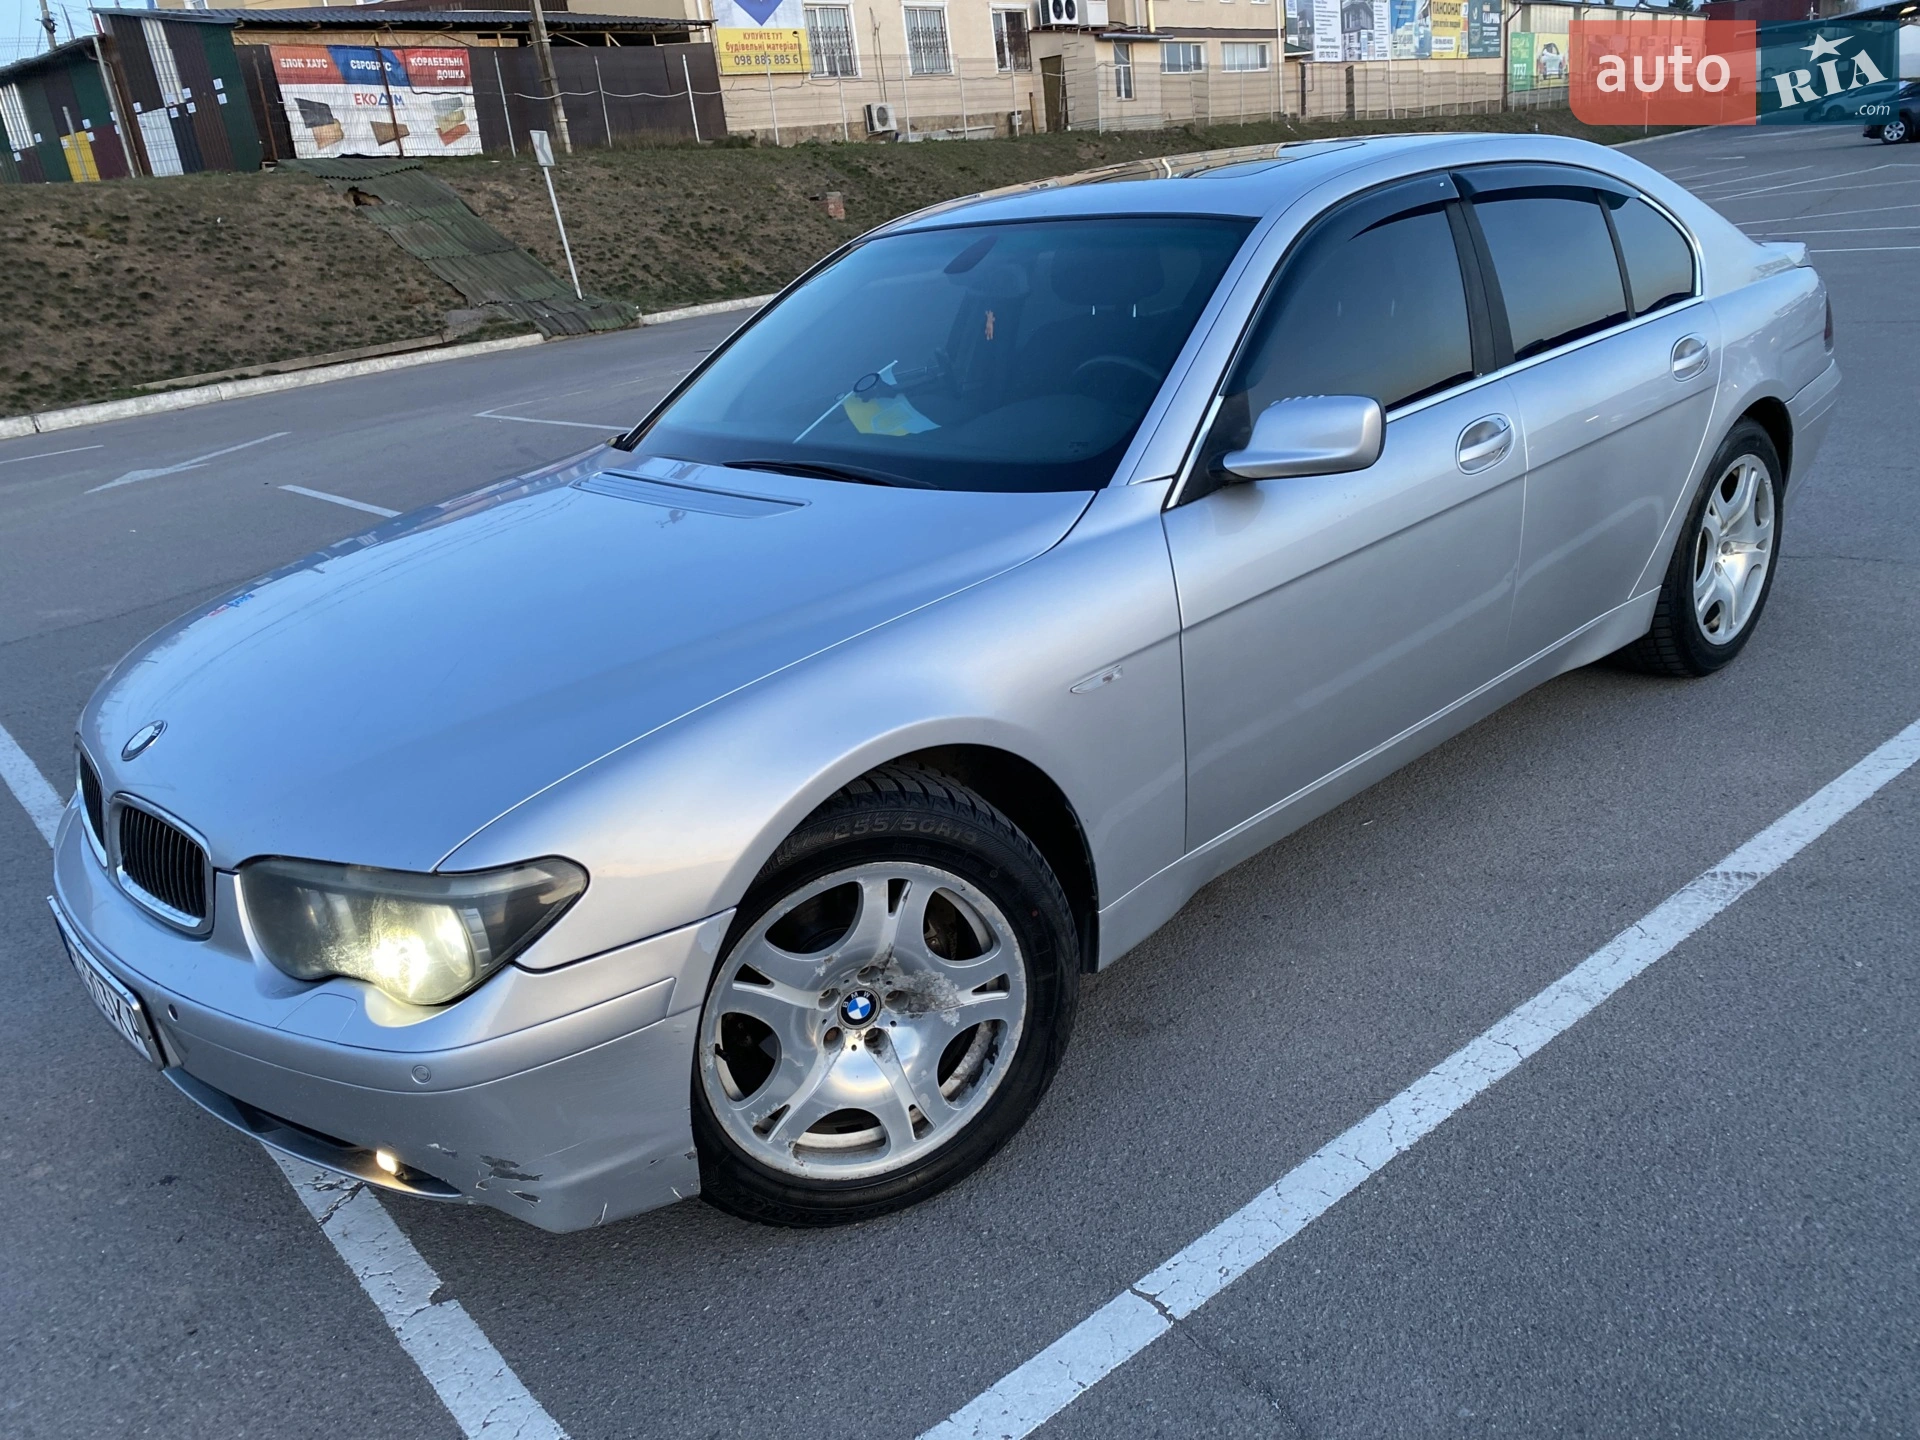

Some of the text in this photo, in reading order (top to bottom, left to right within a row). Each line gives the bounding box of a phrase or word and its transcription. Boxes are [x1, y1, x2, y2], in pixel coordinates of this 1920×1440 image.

[743, 31, 783, 40] КУПУЙТЕ ТУТ
[725, 41, 765, 53] будівельні
[280, 58, 328, 69] БЛОК ХАУС
[350, 59, 392, 71] ЄВРОБРС
[410, 56, 464, 66] КОРАБЕЛЬНА
[734, 55, 752, 65] 098
[774, 54, 790, 64] 885
[793, 54, 799, 64] 6
[437, 69, 466, 80] ДОШКА
[353, 92, 405, 106] ЕКОДМ
[842, 991, 871, 1008] BMW
